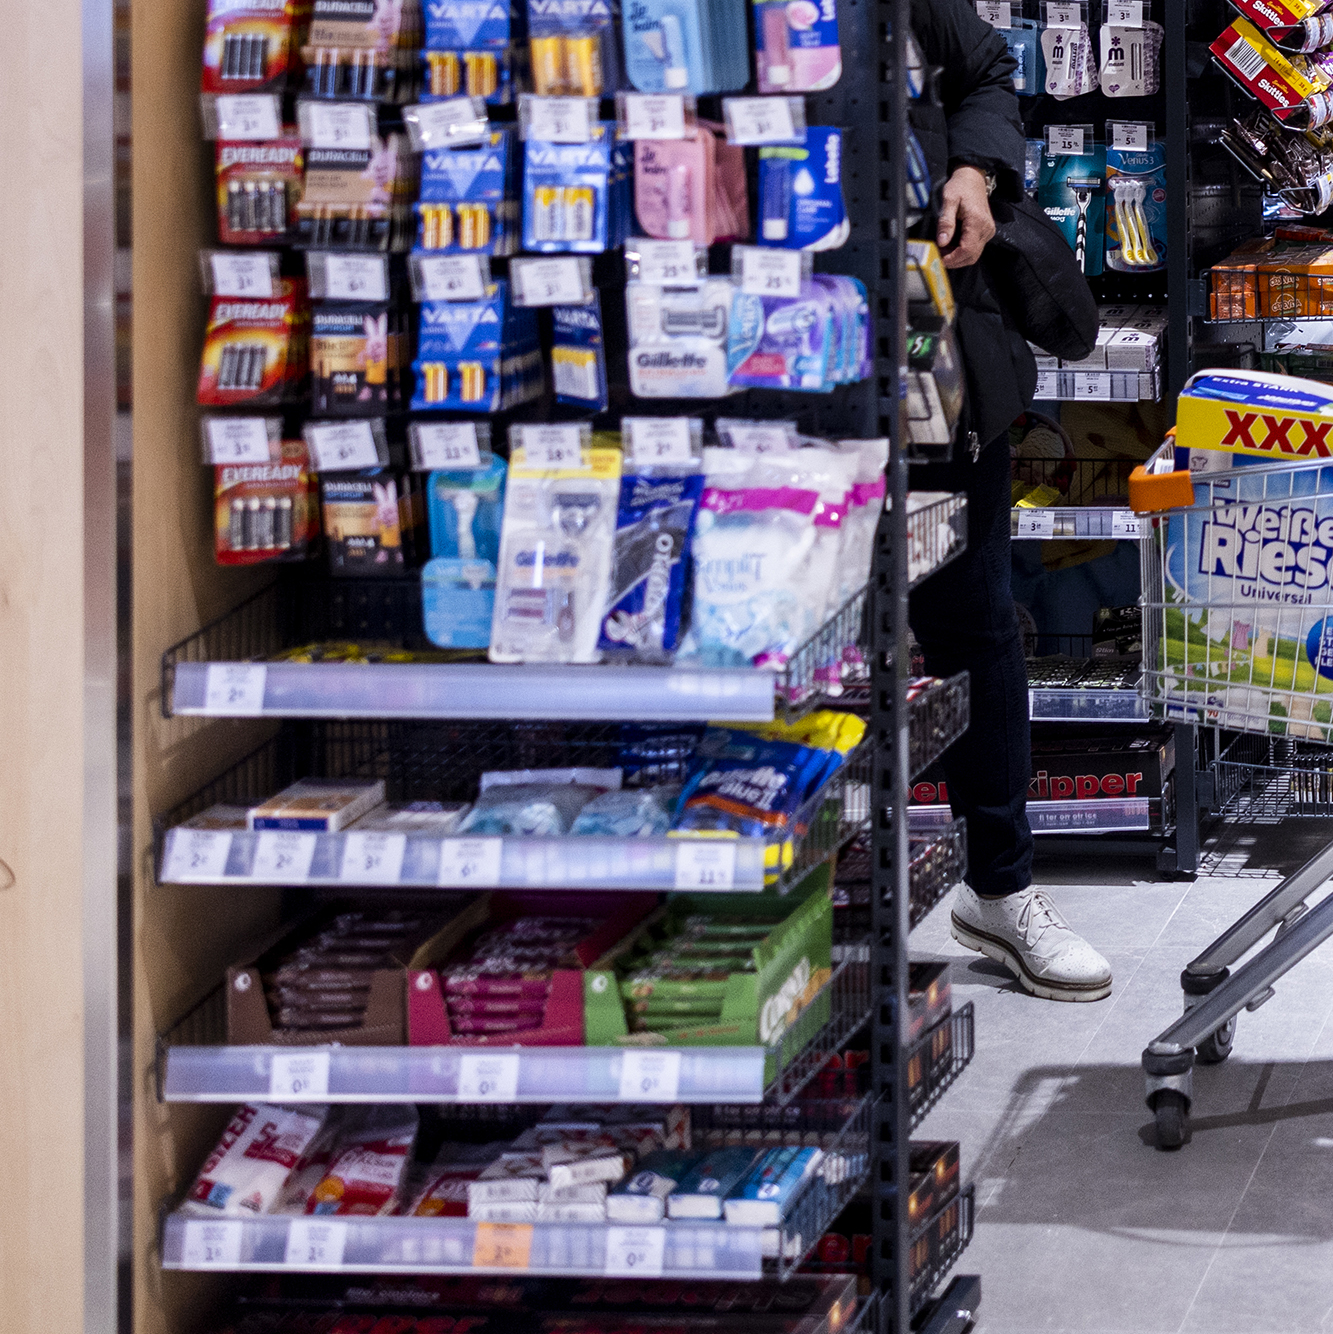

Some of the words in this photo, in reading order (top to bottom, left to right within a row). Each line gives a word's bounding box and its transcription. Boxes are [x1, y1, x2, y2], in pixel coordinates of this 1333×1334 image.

[428, 2, 506, 19] VARTA
[530, 0, 610, 15] VARTA
[1252, 0, 1285, 27] Skittles
[1258, 79, 1290, 107] Skittles
[222, 148, 298, 164] EVEREADY
[425, 156, 502, 171] VARTA
[528, 151, 602, 165] VARTA
[824, 133, 840, 184] Labello
[1118, 153, 1148, 165] Venus
[1044, 207, 1075, 216] Gillette
[216, 303, 290, 319] EVEREADY
[423, 307, 498, 323] VARTA
[636, 353, 707, 368] Gillette
[222, 466, 303, 481] EVEREADY
[1240, 584, 1312, 604] Universal
